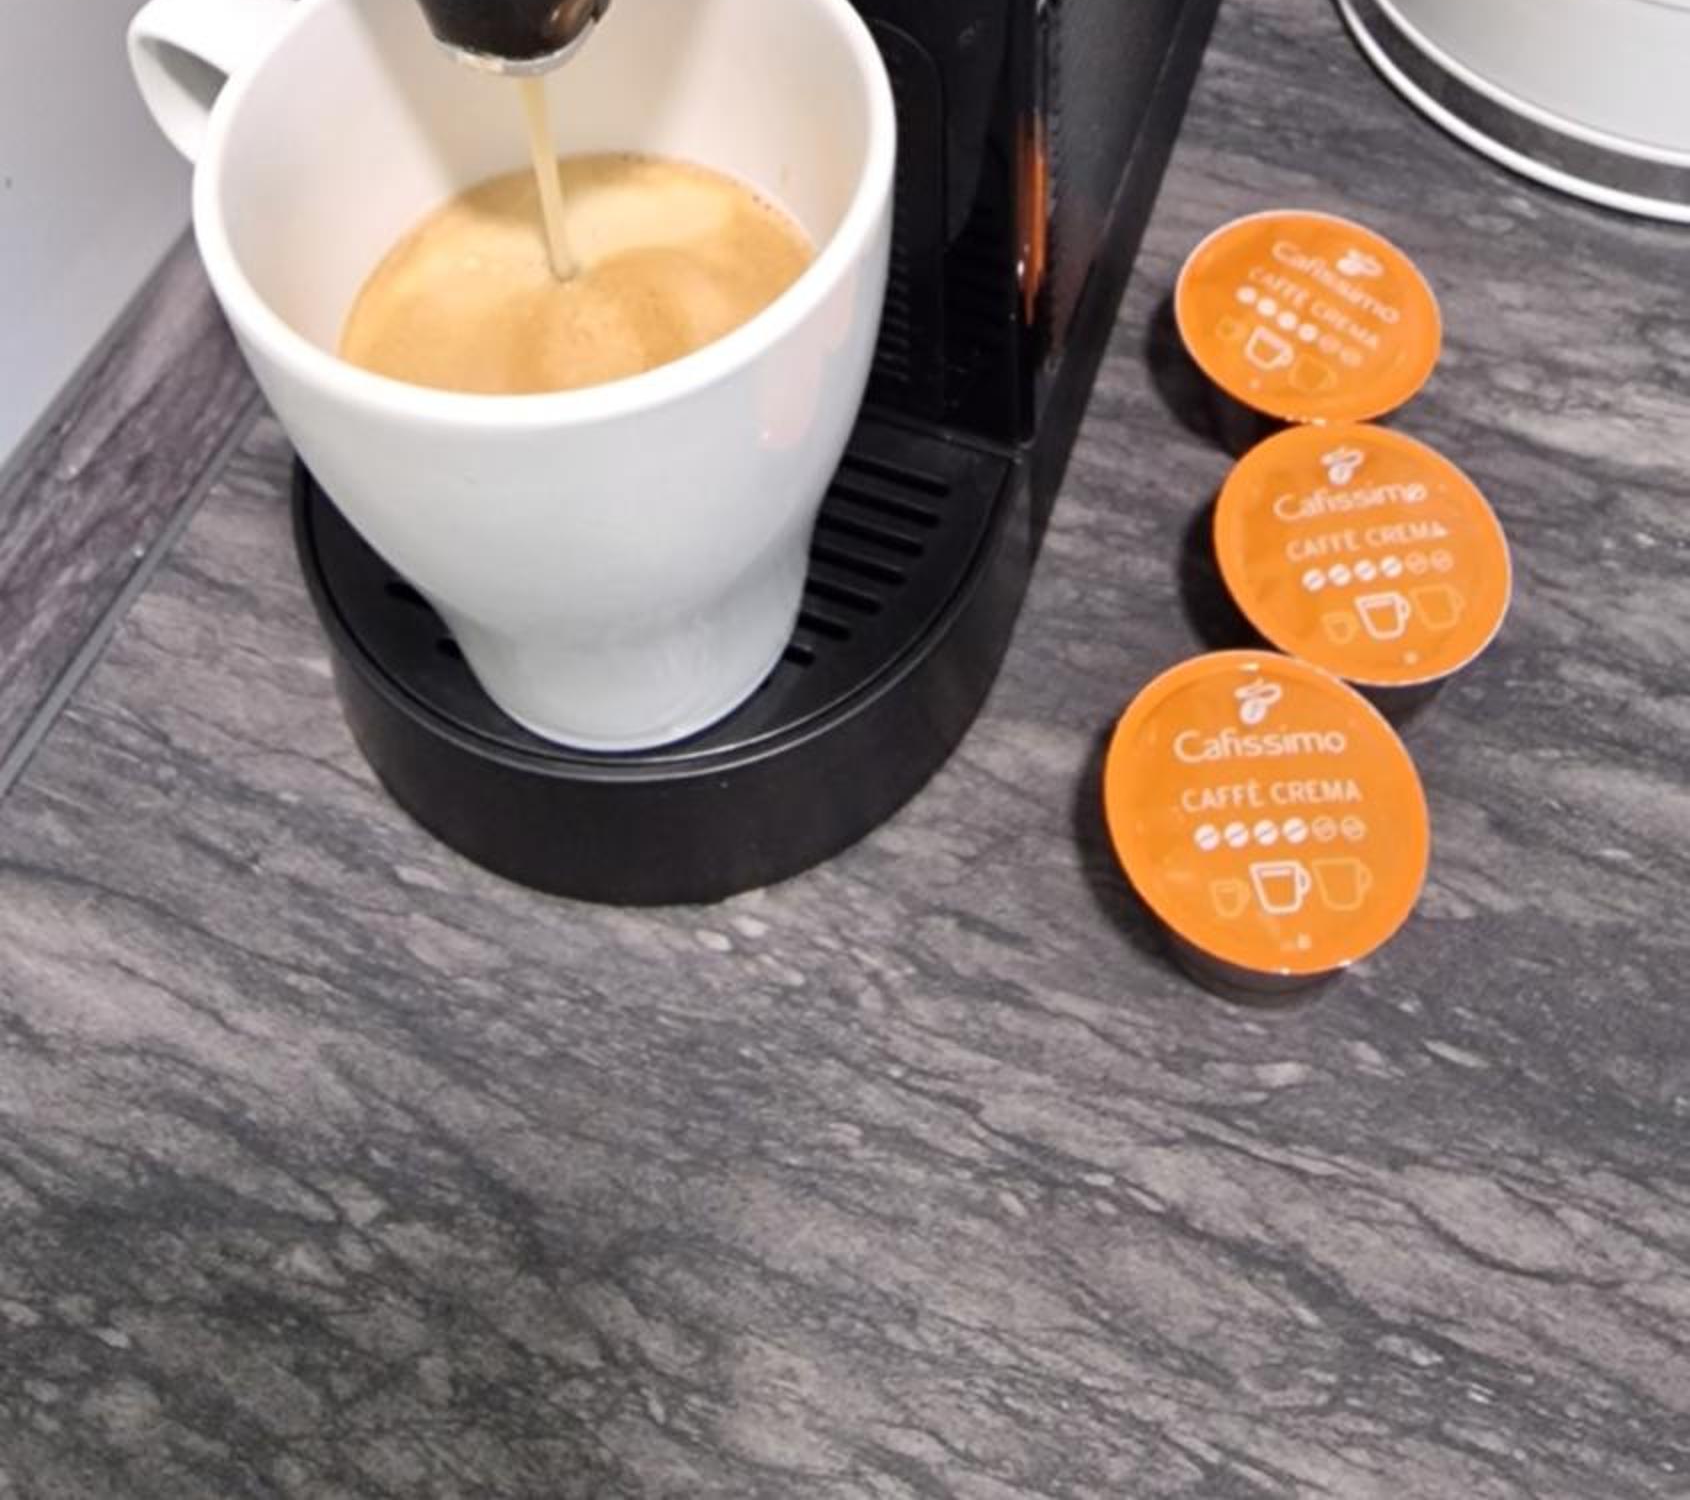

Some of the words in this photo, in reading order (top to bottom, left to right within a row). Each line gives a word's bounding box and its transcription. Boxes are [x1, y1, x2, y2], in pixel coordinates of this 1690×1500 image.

[1273, 481, 1427, 520] Cafissimo
[1365, 521, 1448, 546] CREMA
[1173, 724, 1345, 763] Cafissimo
[1270, 778, 1361, 804] CREMA
